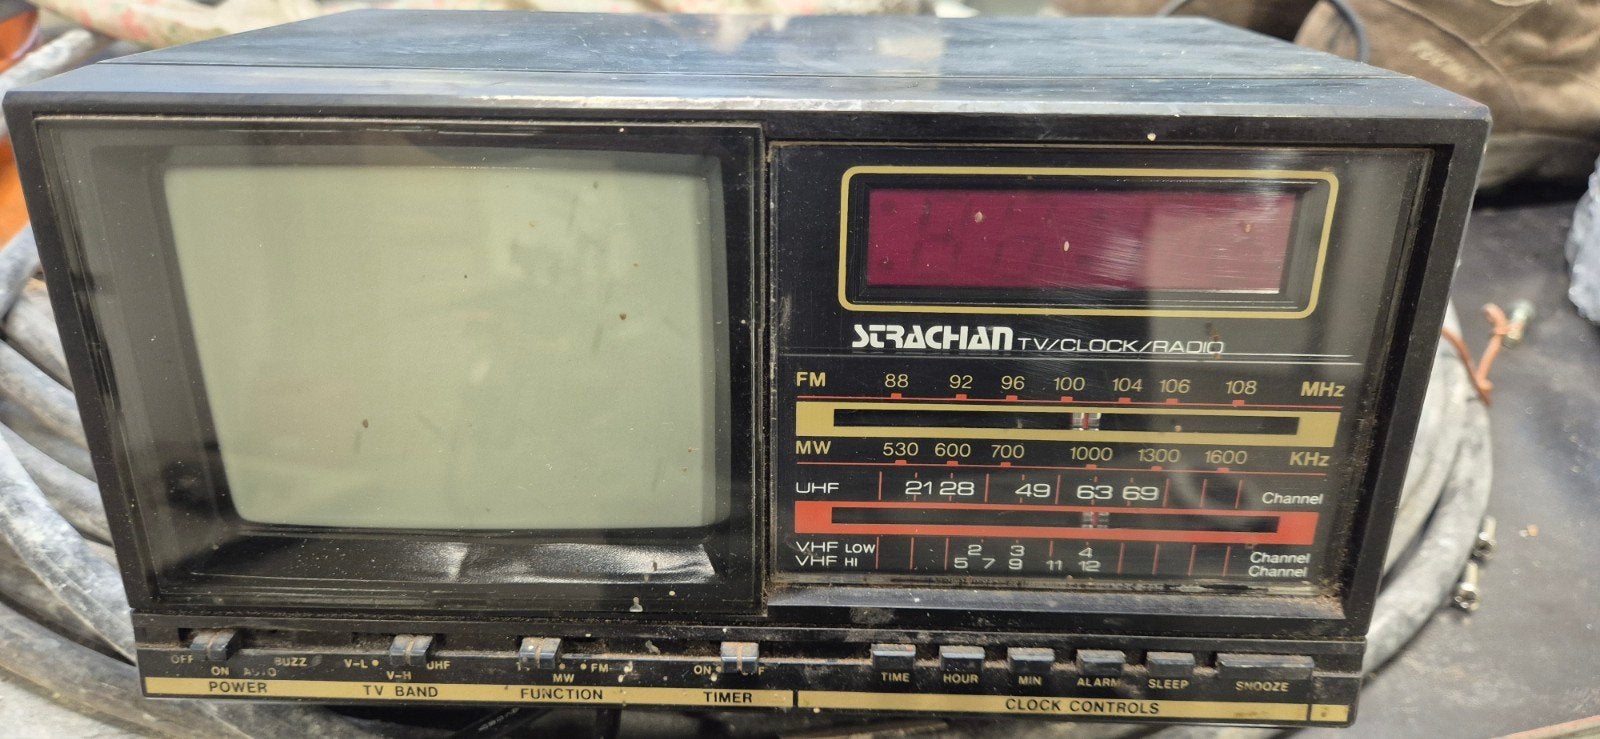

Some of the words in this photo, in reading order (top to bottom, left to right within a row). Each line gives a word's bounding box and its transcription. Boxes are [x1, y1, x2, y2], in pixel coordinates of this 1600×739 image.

[851, 324, 1013, 351] STRACHAN
[1017, 336, 1225, 354] TV/CLOCK/RADIO
[796, 371, 826, 387] FM
[884, 373, 909, 388] 88
[949, 374, 973, 389] 92
[1001, 375, 1025, 390] 96
[1054, 376, 1085, 391] 100
[1112, 377, 1143, 393] 104
[1159, 378, 1190, 394] 106
[1226, 380, 1257, 396] 108
[1300, 381, 1346, 398] MHz
[795, 440, 831, 455] MW
[882, 442, 919, 457] 530
[934, 443, 971, 458] 600
[991, 444, 1025, 459] 700
[1070, 446, 1113, 462] 1000
[1138, 448, 1180, 464] 1300
[1205, 450, 1247, 465] 1600
[1289, 451, 1330, 467] KHz
[795, 482, 839, 494] UHF
[905, 480, 932, 495] 21
[939, 481, 975, 496] 28
[1015, 483, 1051, 498] 49
[1077, 485, 1113, 500] 63
[1122, 486, 1159, 501] 69
[1261, 491, 1324, 506] Channel
[795, 541, 838, 553] VHF
[845, 543, 876, 554] LOW
[967, 544, 982, 556] 2
[1010, 545, 1025, 556] 3
[1078, 547, 1093, 559] 4
[1250, 551, 1311, 565] Channel
[795, 555, 838, 567] VHF
[844, 557, 858, 567] HI
[953, 557, 969, 569] 5
[981, 558, 996, 570] 7
[1008, 558, 1023, 570] 9
[1045, 560, 1063, 571] 11
[1078, 560, 1101, 572] 12
[1248, 565, 1308, 579] Channel
[170, 654, 194, 664] OFF
[274, 657, 308, 668] BUZZ
[210, 666, 231, 677] ON
[426, 660, 451, 671] UHF
[590, 663, 610, 673] FM
[693, 664, 713, 676] ON
[552, 673, 576, 684] MW
[880, 672, 911, 683] TIME
[942, 673, 980, 685] HOUR
[1018, 675, 1043, 686] MIN
[1076, 677, 1122, 688] ALARM
[208, 681, 268, 694] POWER
[1147, 679, 1191, 690] SLEEP
[1234, 681, 1290, 693] SNOOZE
[363, 685, 385, 696] TV
[395, 686, 439, 698] BAND
[520, 688, 604, 701] FUNCTION
[703, 691, 753, 704] TIMER
[1005, 698, 1062, 712] CLOCK
[1069, 701, 1160, 715] CONTROLS
